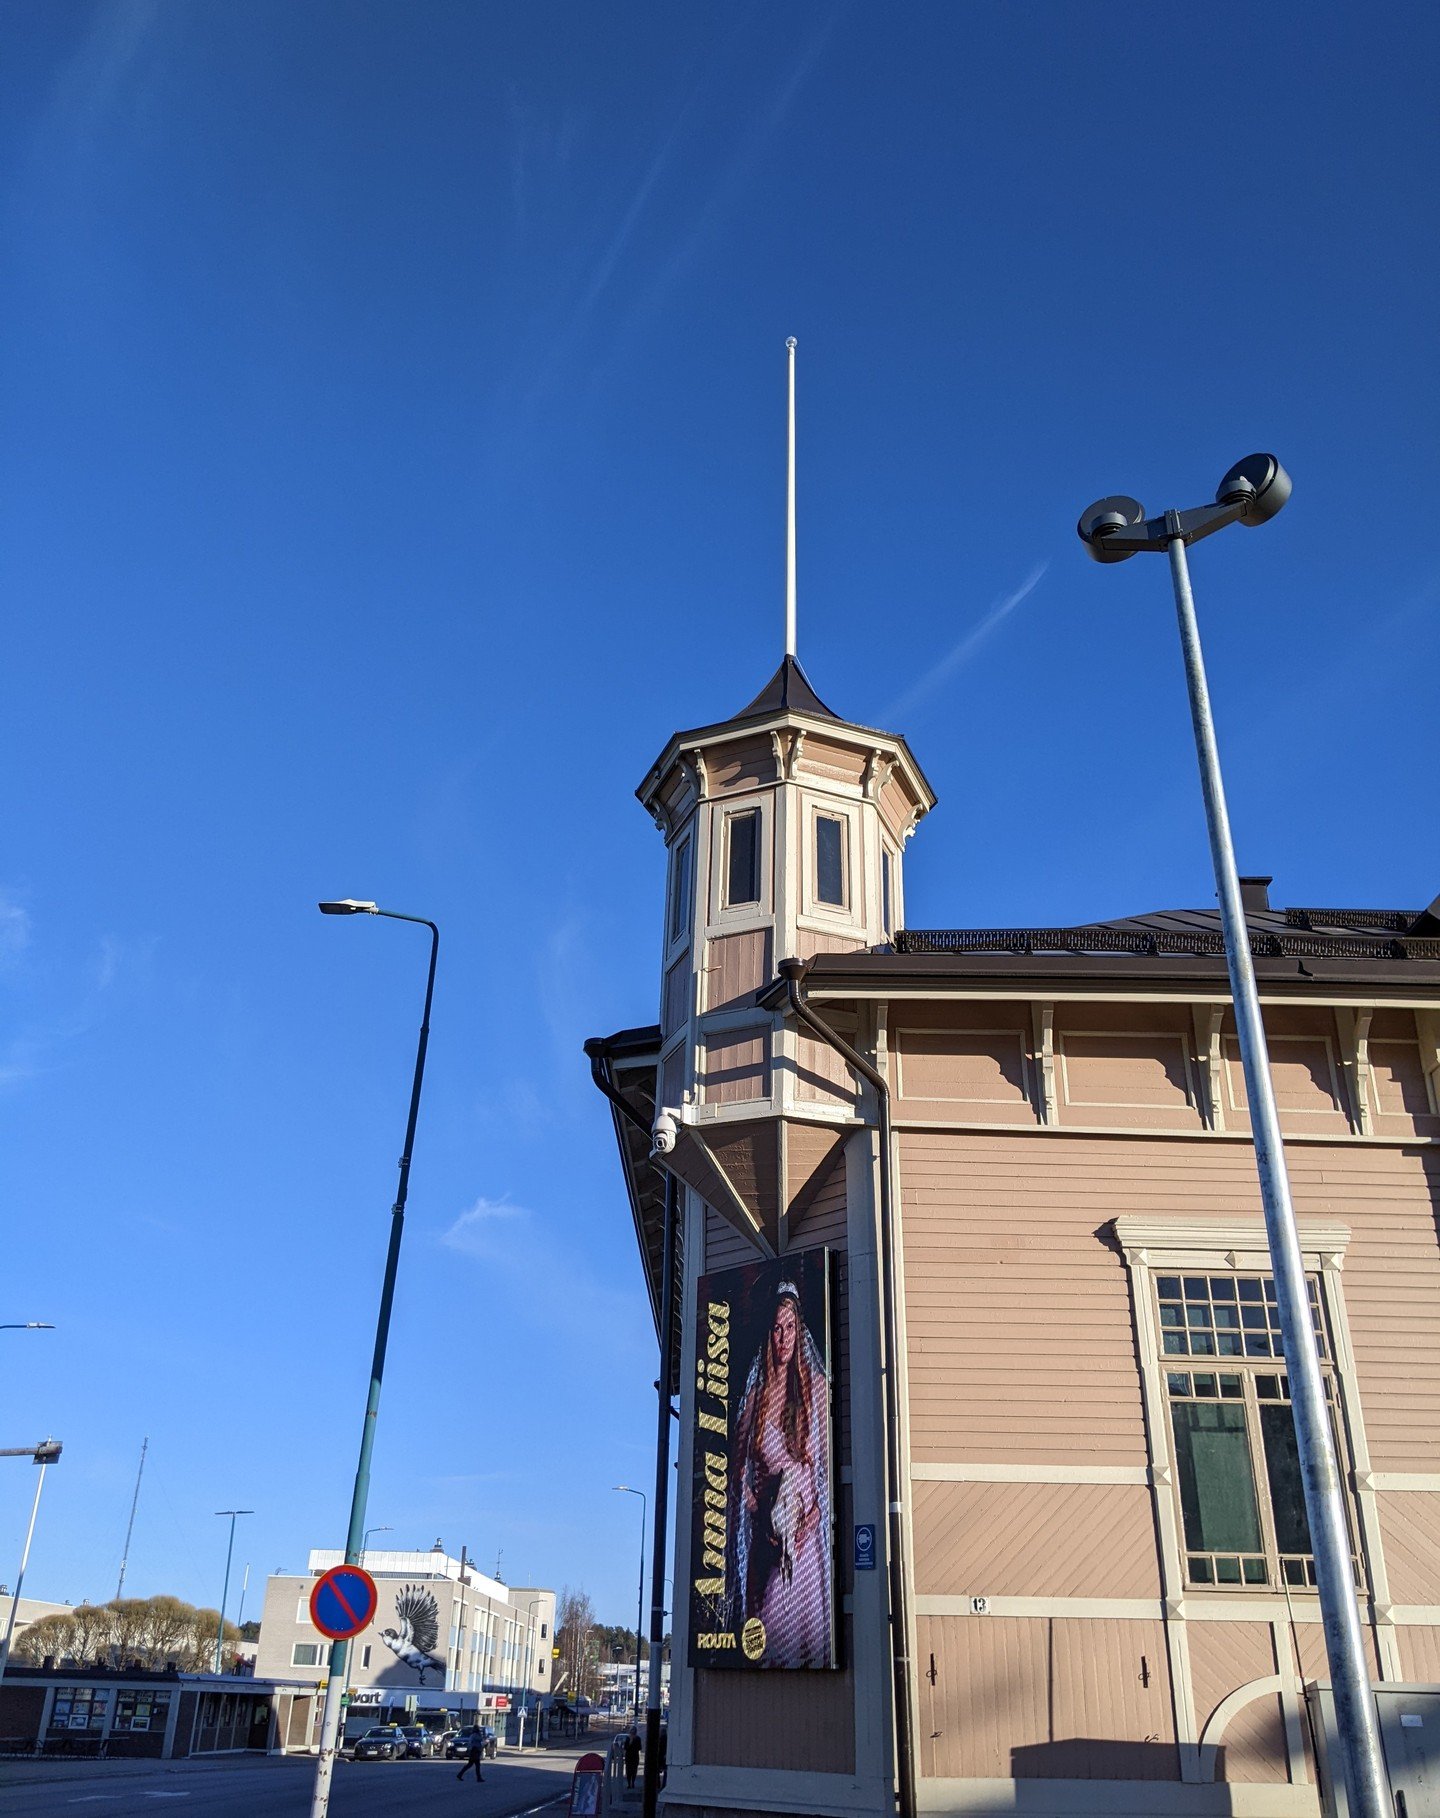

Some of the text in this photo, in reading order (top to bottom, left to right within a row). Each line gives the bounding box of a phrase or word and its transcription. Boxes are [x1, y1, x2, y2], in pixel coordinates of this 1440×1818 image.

[694, 1300, 732, 1625] Anna Liisa
[973, 1598, 986, 1612] 13
[697, 1633, 737, 1649] ROUTA
